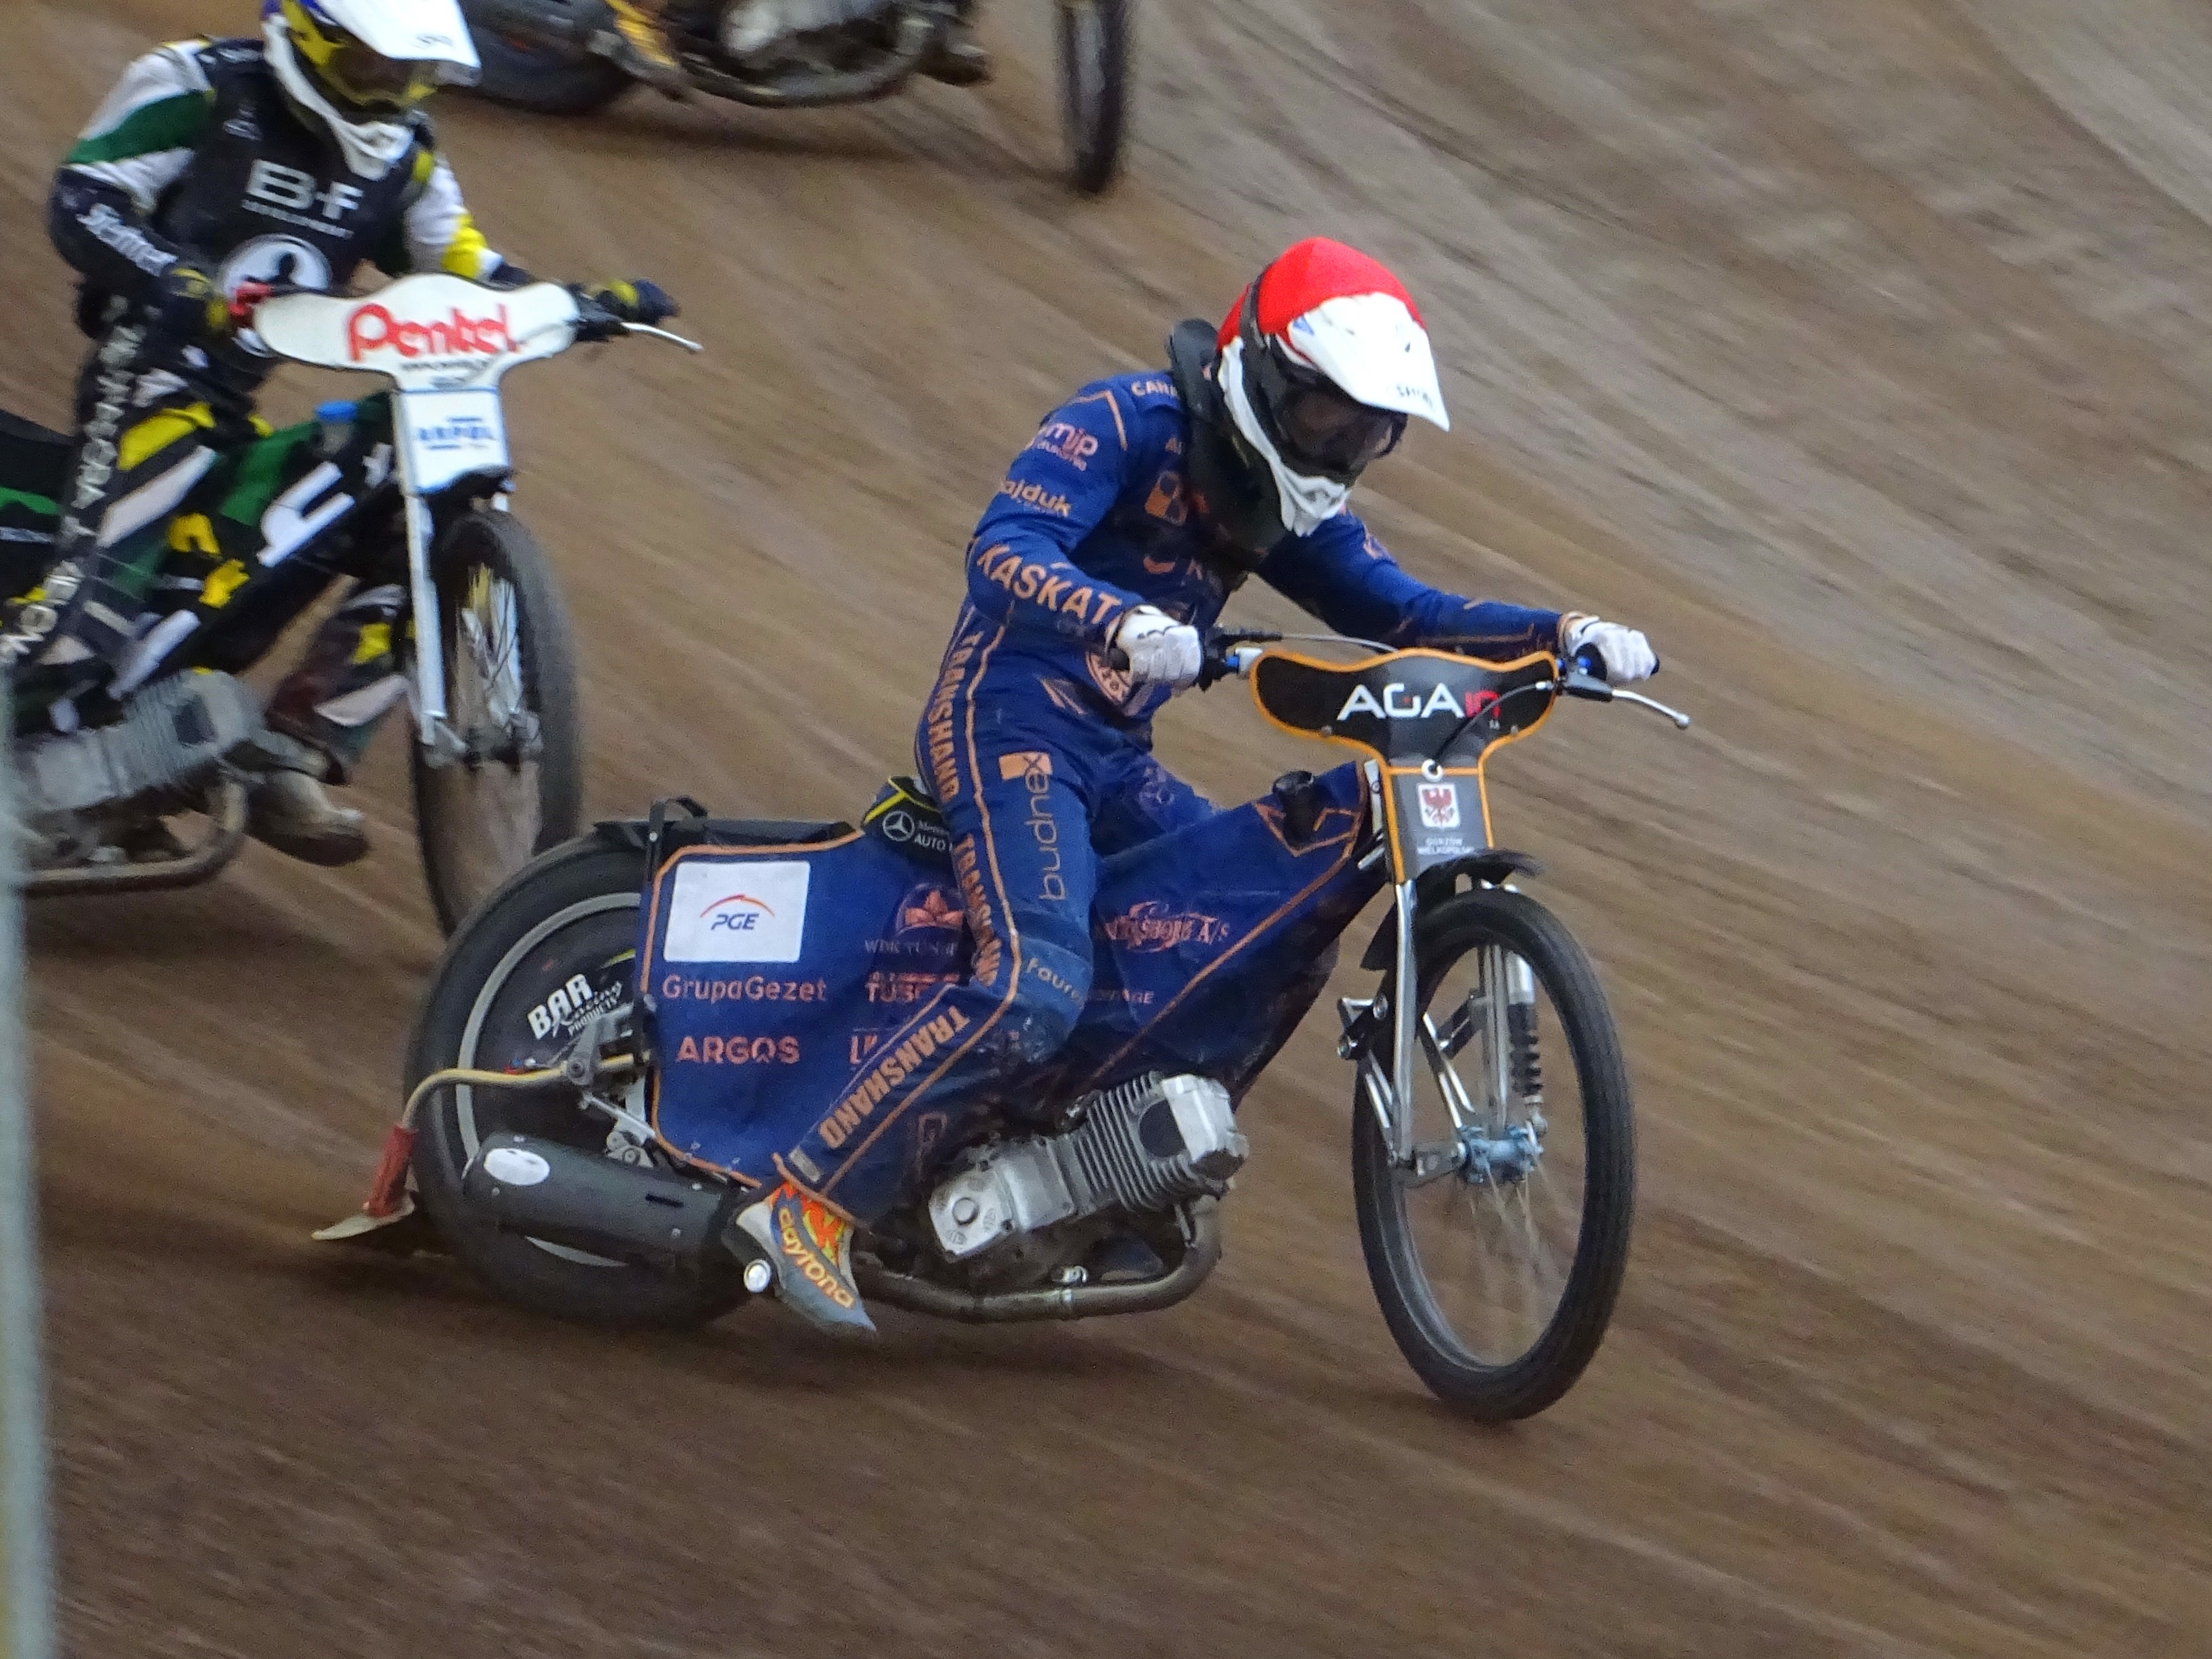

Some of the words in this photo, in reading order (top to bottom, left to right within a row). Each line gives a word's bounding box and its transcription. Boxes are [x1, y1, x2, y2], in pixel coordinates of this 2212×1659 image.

[346, 302, 518, 362] Pentel
[977, 544, 1122, 625] KASKAT
[711, 913, 759, 930] PGE
[527, 973, 593, 1040] BAR
[676, 1035, 800, 1064] ARGOS
